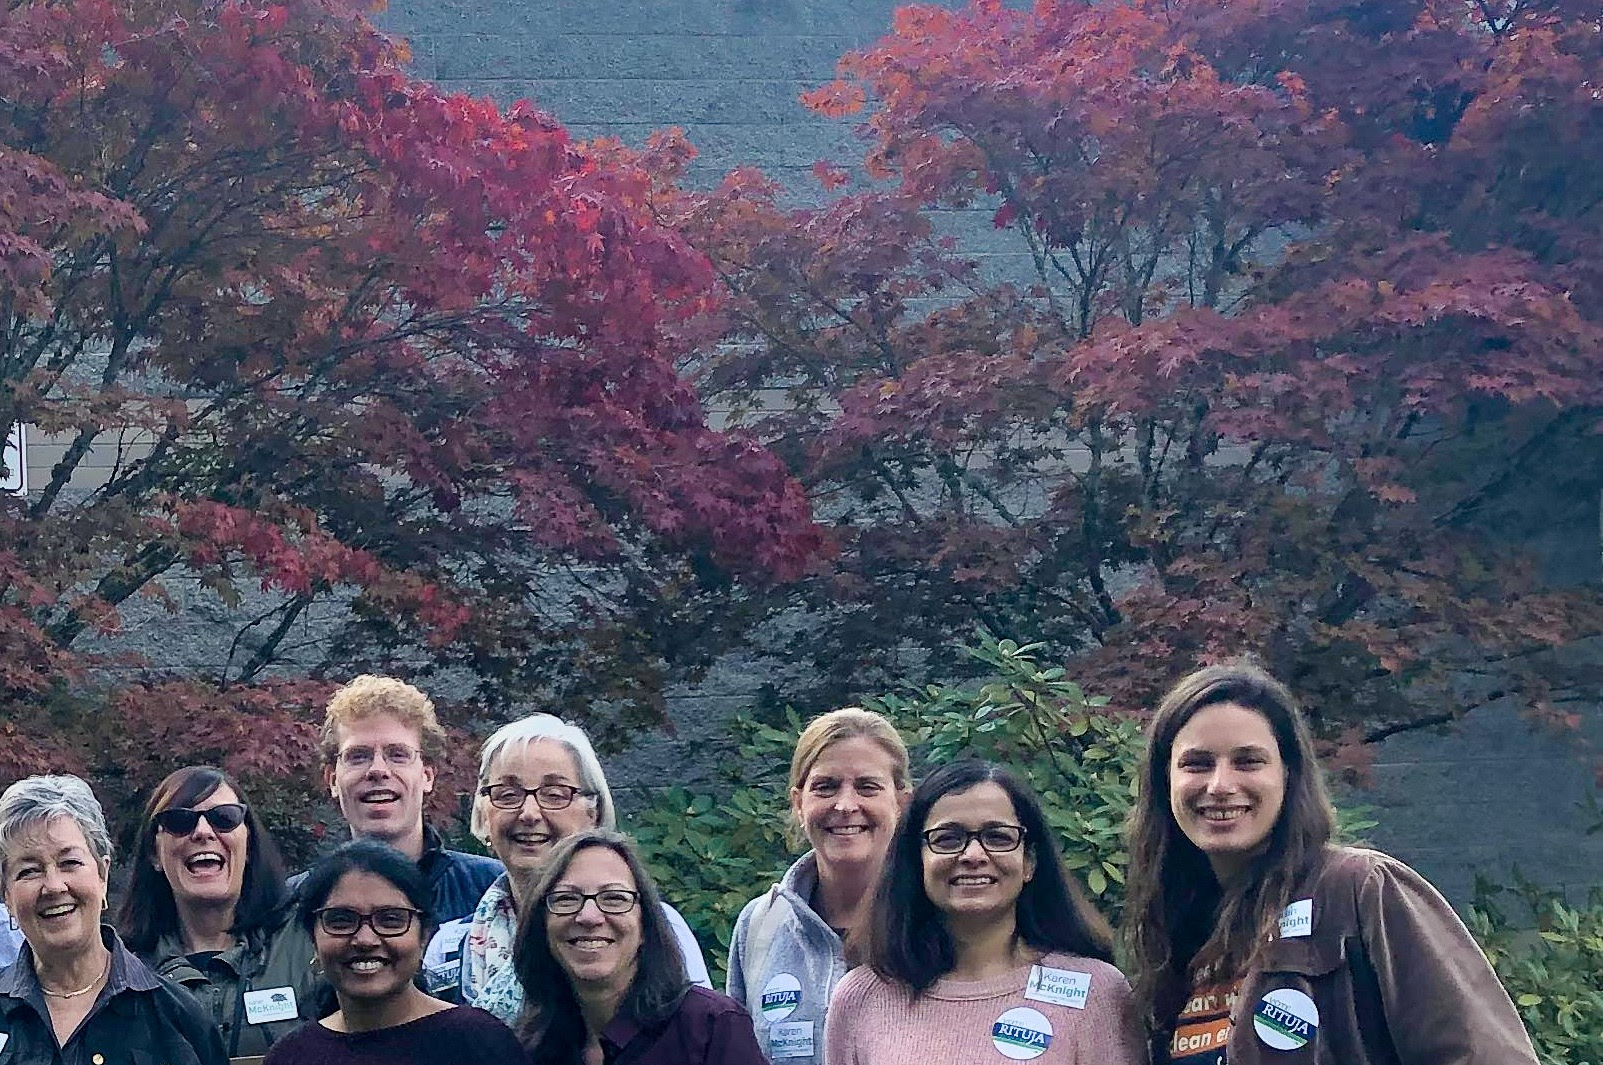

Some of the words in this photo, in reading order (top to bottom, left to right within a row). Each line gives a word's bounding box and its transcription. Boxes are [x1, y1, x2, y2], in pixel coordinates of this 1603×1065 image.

[1044, 972, 1076, 984] Karen
[765, 991, 796, 1005] RITUJA
[1262, 1003, 1308, 1035] RITUJA
[999, 1024, 1045, 1045] RITUJA
